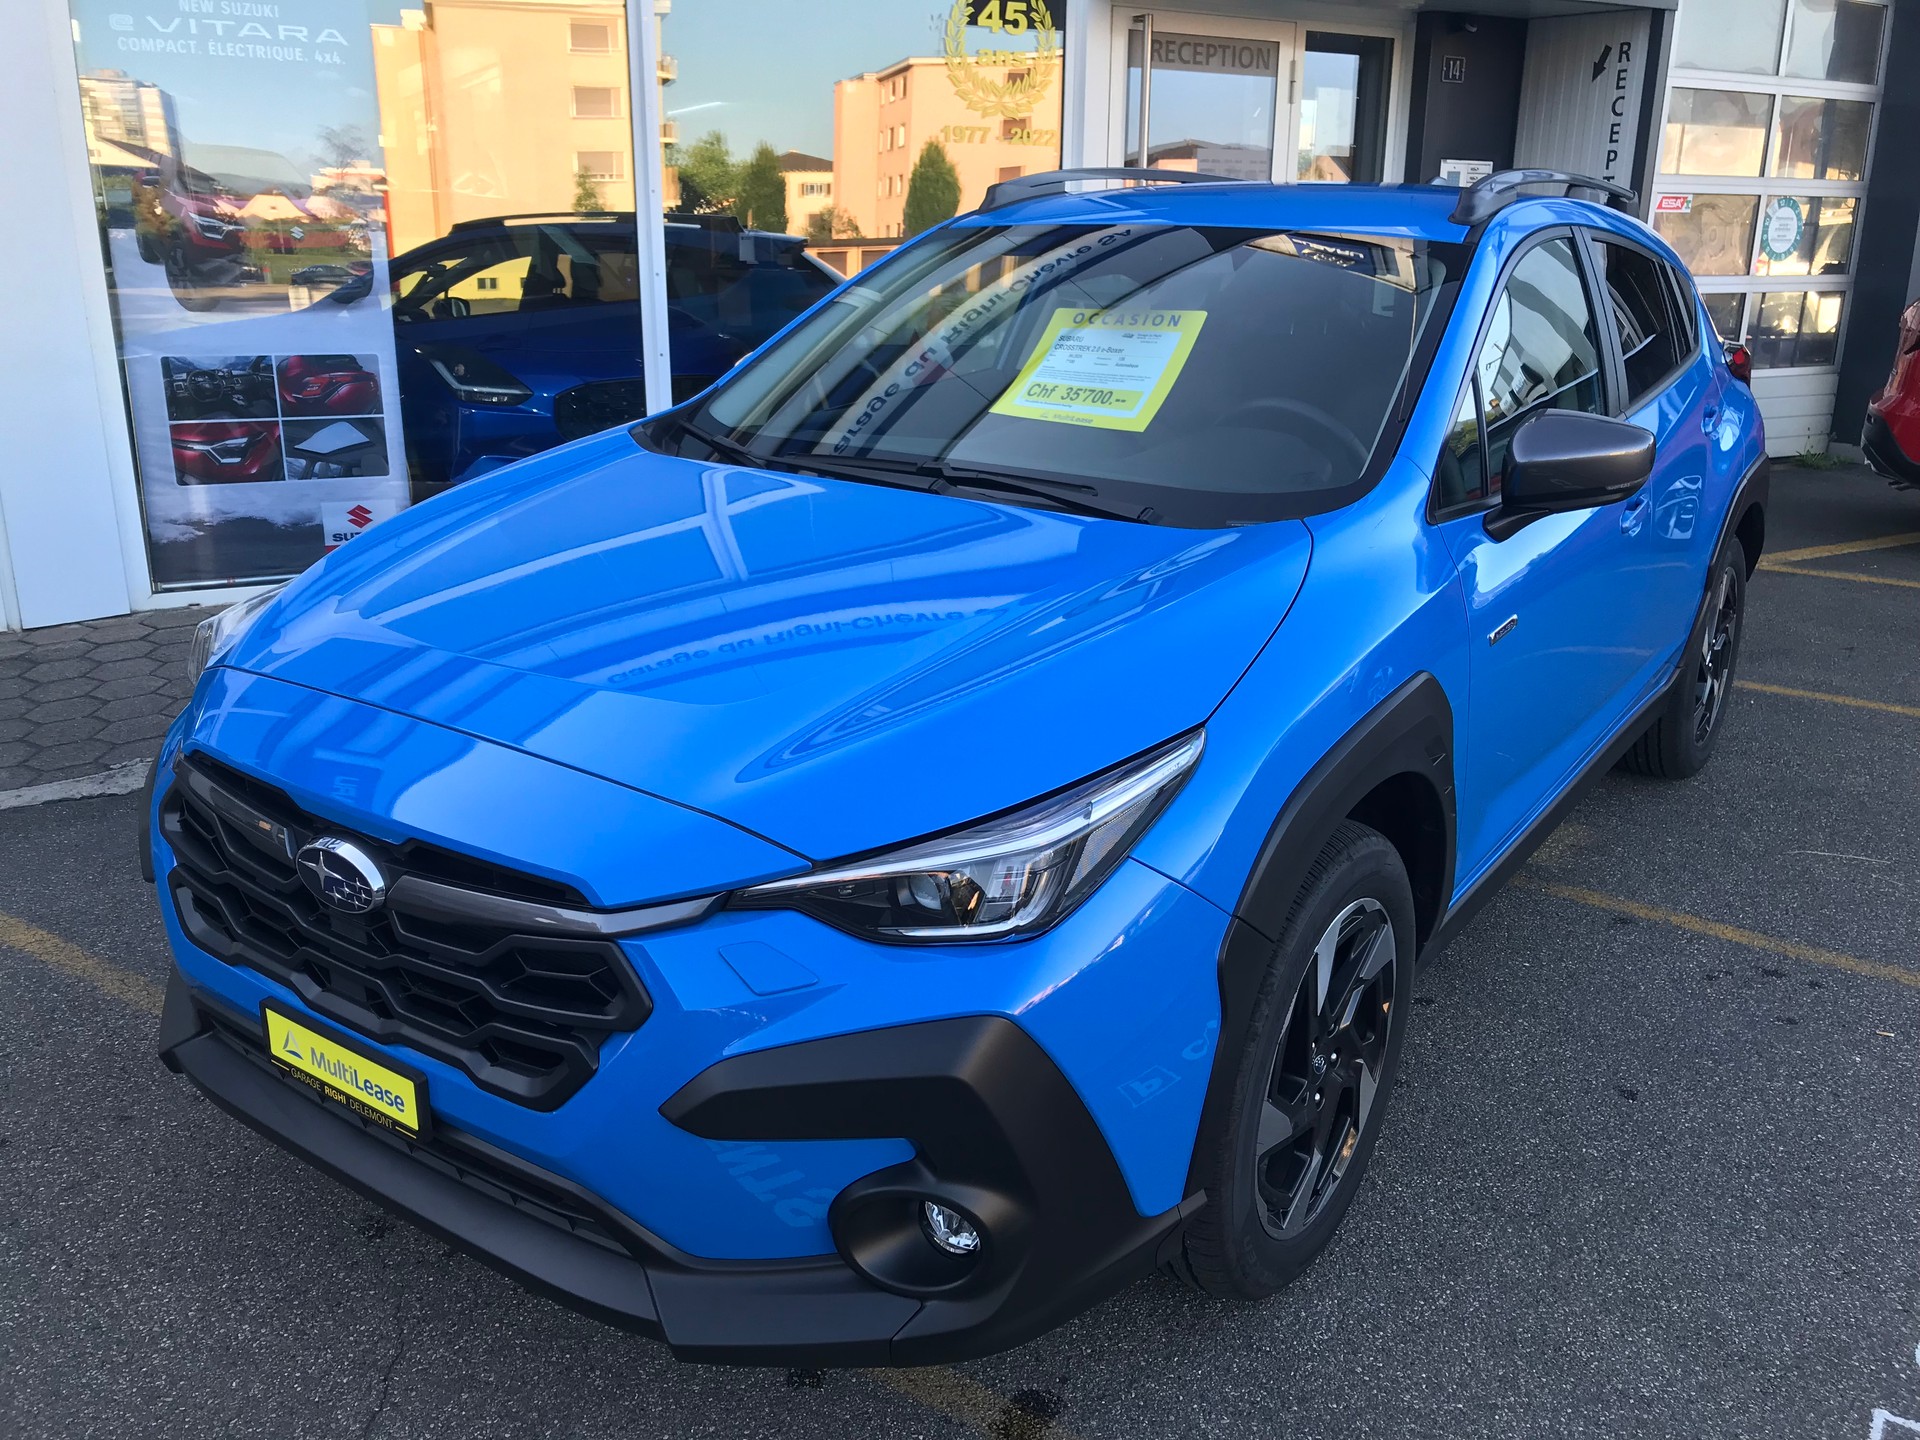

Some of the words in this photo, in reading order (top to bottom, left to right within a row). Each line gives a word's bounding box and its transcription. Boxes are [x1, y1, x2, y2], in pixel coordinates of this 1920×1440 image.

[179, 0, 214, 13] NEW
[220, 1, 279, 18] SUZUKI
[977, 0, 1029, 35] 45
[145, 15, 350, 46] VITARA
[117, 36, 202, 54] COMPACT.
[208, 39, 309, 62] ÉLECTRIQUE.
[314, 49, 346, 65] 4x4.
[976, 48, 1028, 67] ans
[1151, 39, 1271, 70] RECEPTION
[1449, 60, 1461, 80] 14
[940, 124, 992, 144] 1977
[1008, 127, 1057, 147] 2022
[1072, 312, 1182, 328] OCCASION
[1054, 343, 1091, 352] CROSSTREK
[1026, 383, 1059, 399] Chf
[1061, 387, 1127, 406] 35'700.--
[332, 531, 362, 542] SU
[310, 1046, 405, 1113] MultiLease
[290, 1067, 322, 1091] GARAGE
[324, 1085, 347, 1105] RIGHI
[349, 1099, 394, 1129] DELEMONT
